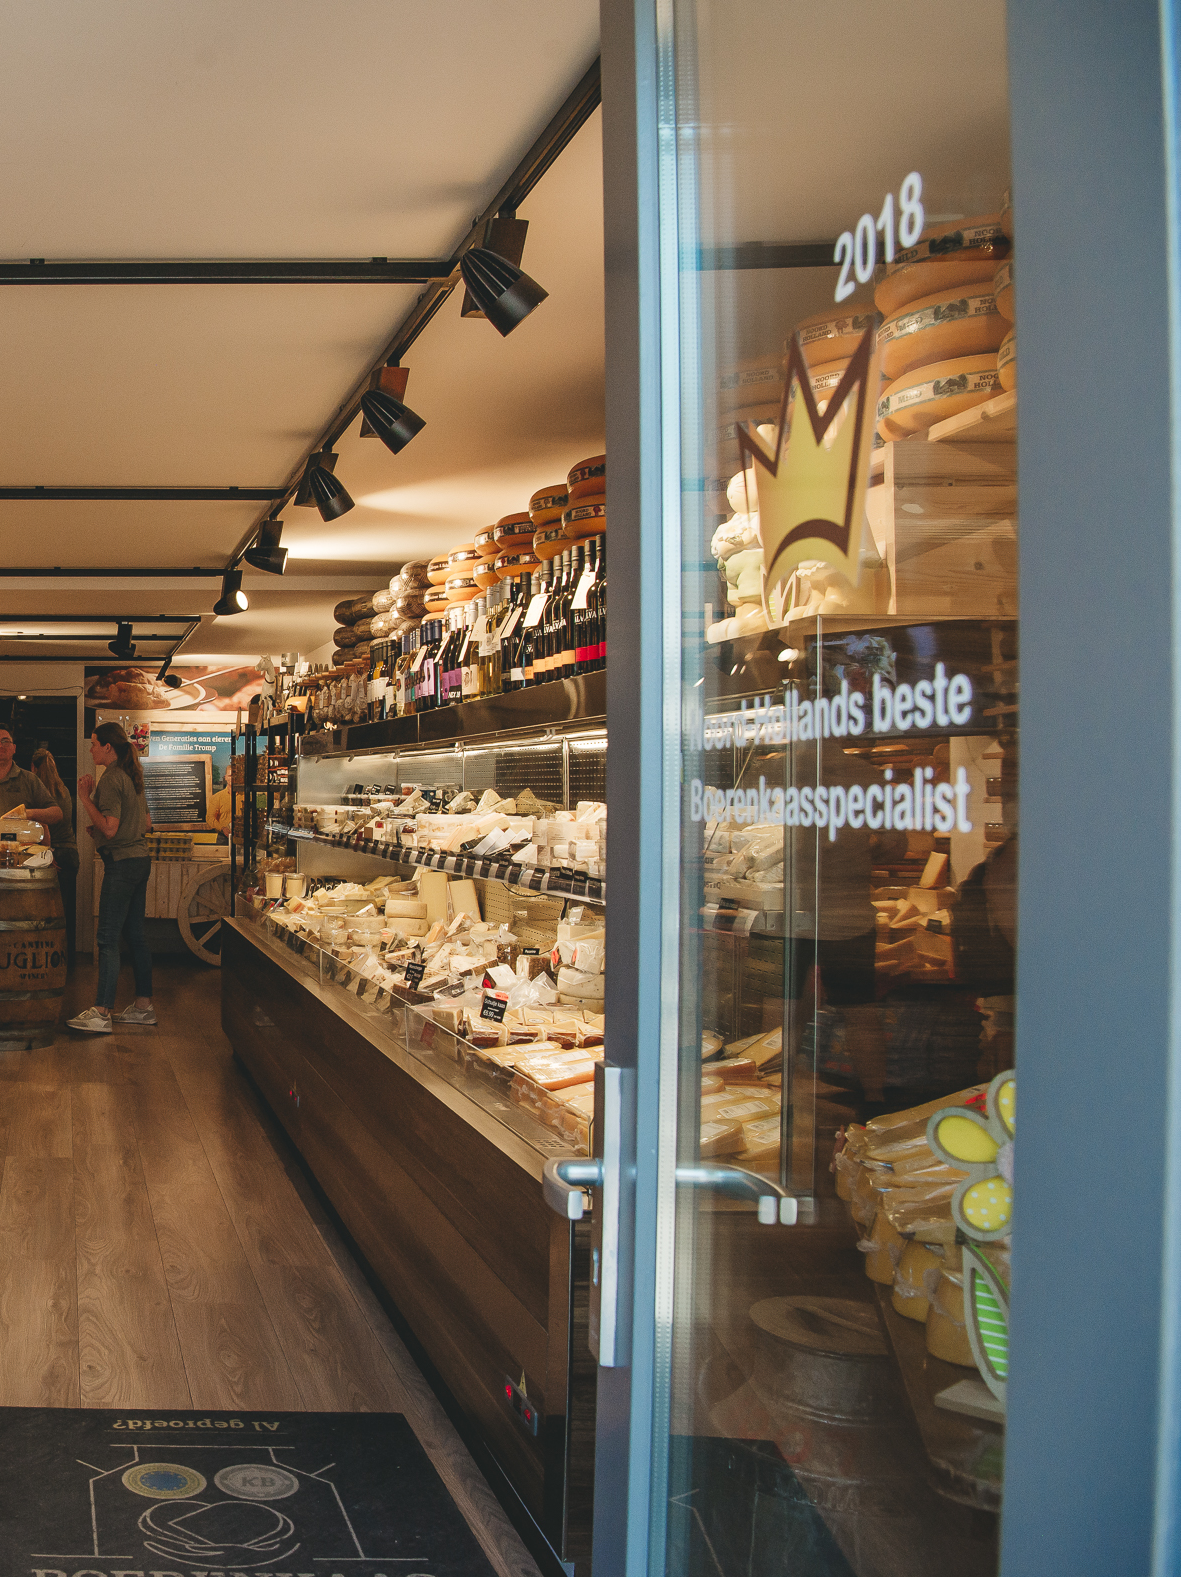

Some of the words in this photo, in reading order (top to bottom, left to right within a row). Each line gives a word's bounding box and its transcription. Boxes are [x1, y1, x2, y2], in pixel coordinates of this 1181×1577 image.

[834, 171, 925, 303] 2018
[974, 227, 1002, 238] NOOR
[805, 324, 828, 335] NOORD
[802, 330, 832, 343] HOLLAND
[872, 661, 972, 733] beste
[161, 735, 198, 743] Generaties
[194, 744, 217, 753] Tromp
[689, 766, 973, 842] Boerenkaasspecialist
[112, 1418, 245, 1431] geproefd?
[251, 1421, 281, 1431] Al
[241, 1475, 277, 1488] KB
